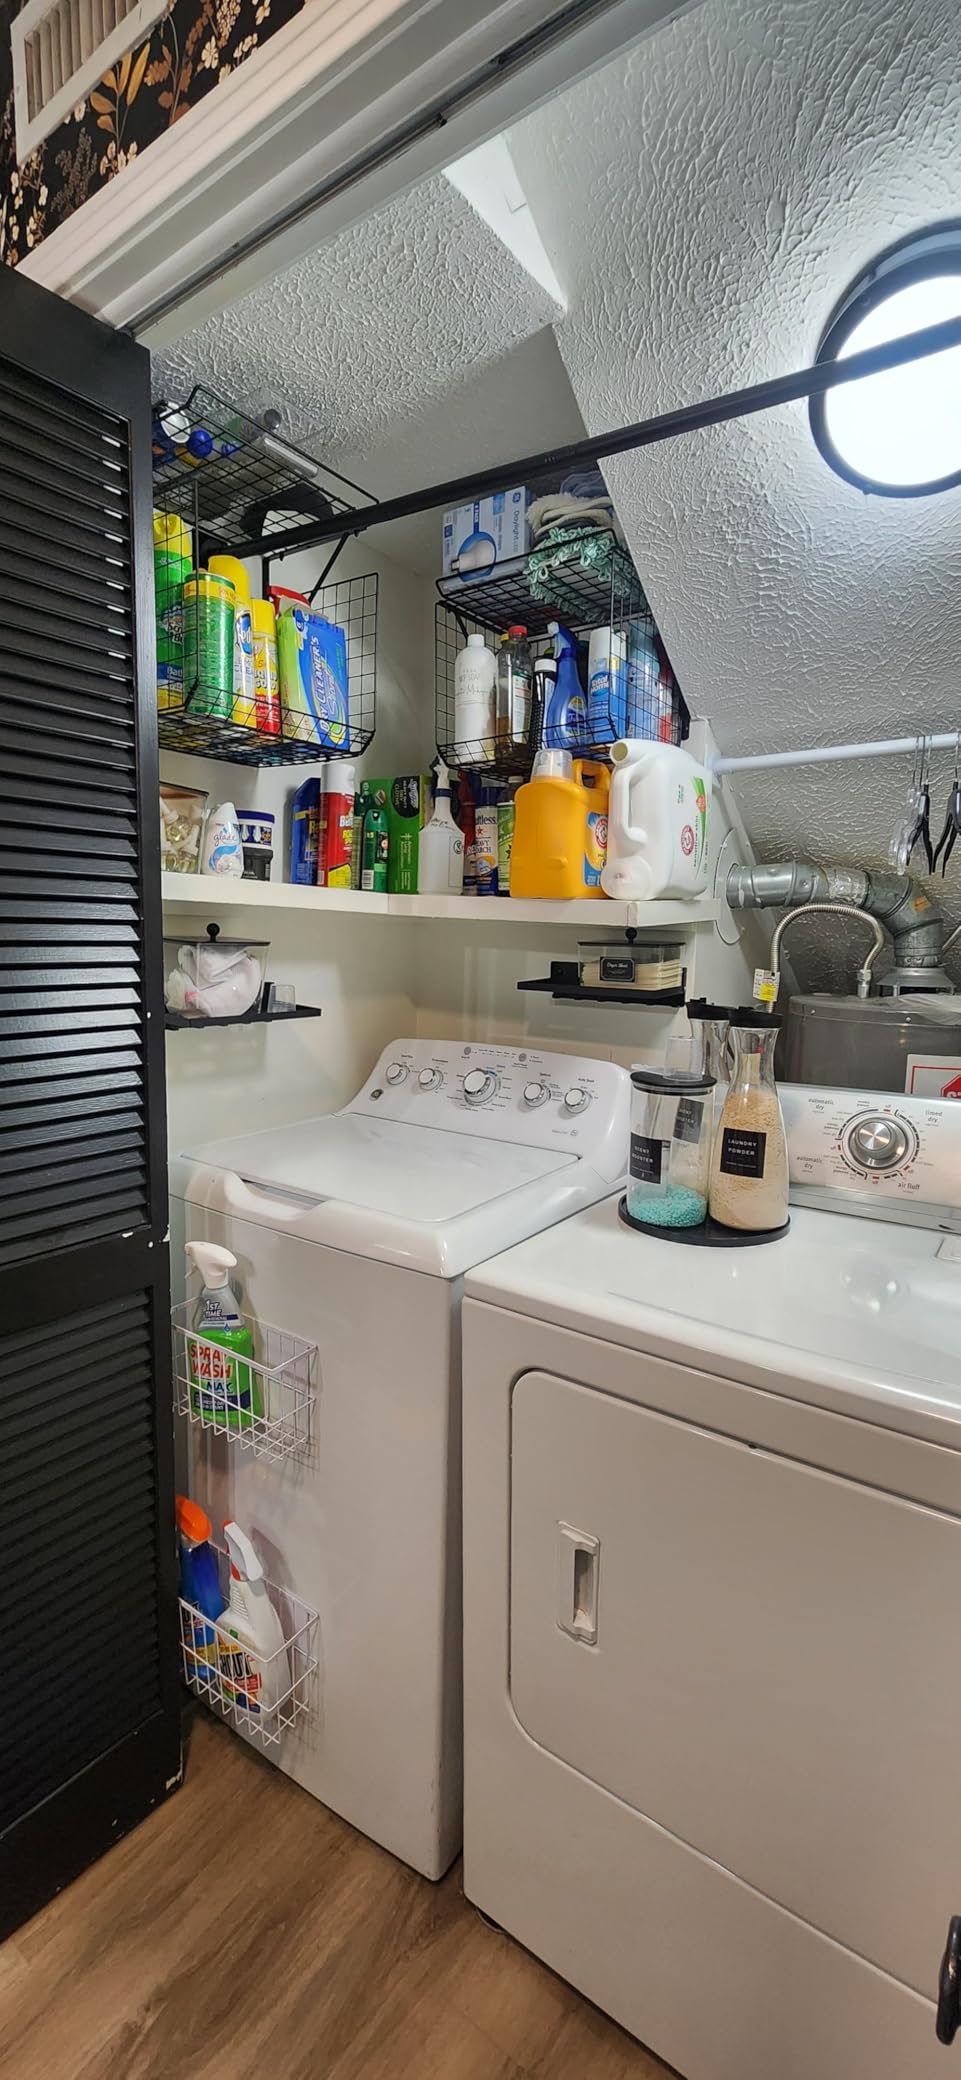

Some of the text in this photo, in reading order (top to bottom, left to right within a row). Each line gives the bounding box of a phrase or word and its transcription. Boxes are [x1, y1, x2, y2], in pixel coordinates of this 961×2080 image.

[808, 1097, 834, 1106] automatic
[727, 1138, 757, 1147] LAUNDRY
[727, 1147, 755, 1156] POWDER
[631, 1153, 654, 1164] BOOSTER
[796, 1155, 823, 1164] automatic
[804, 1162, 813, 1170] dry
[907, 1182, 920, 1190] fluff
[192, 1361, 233, 1379] WASH
